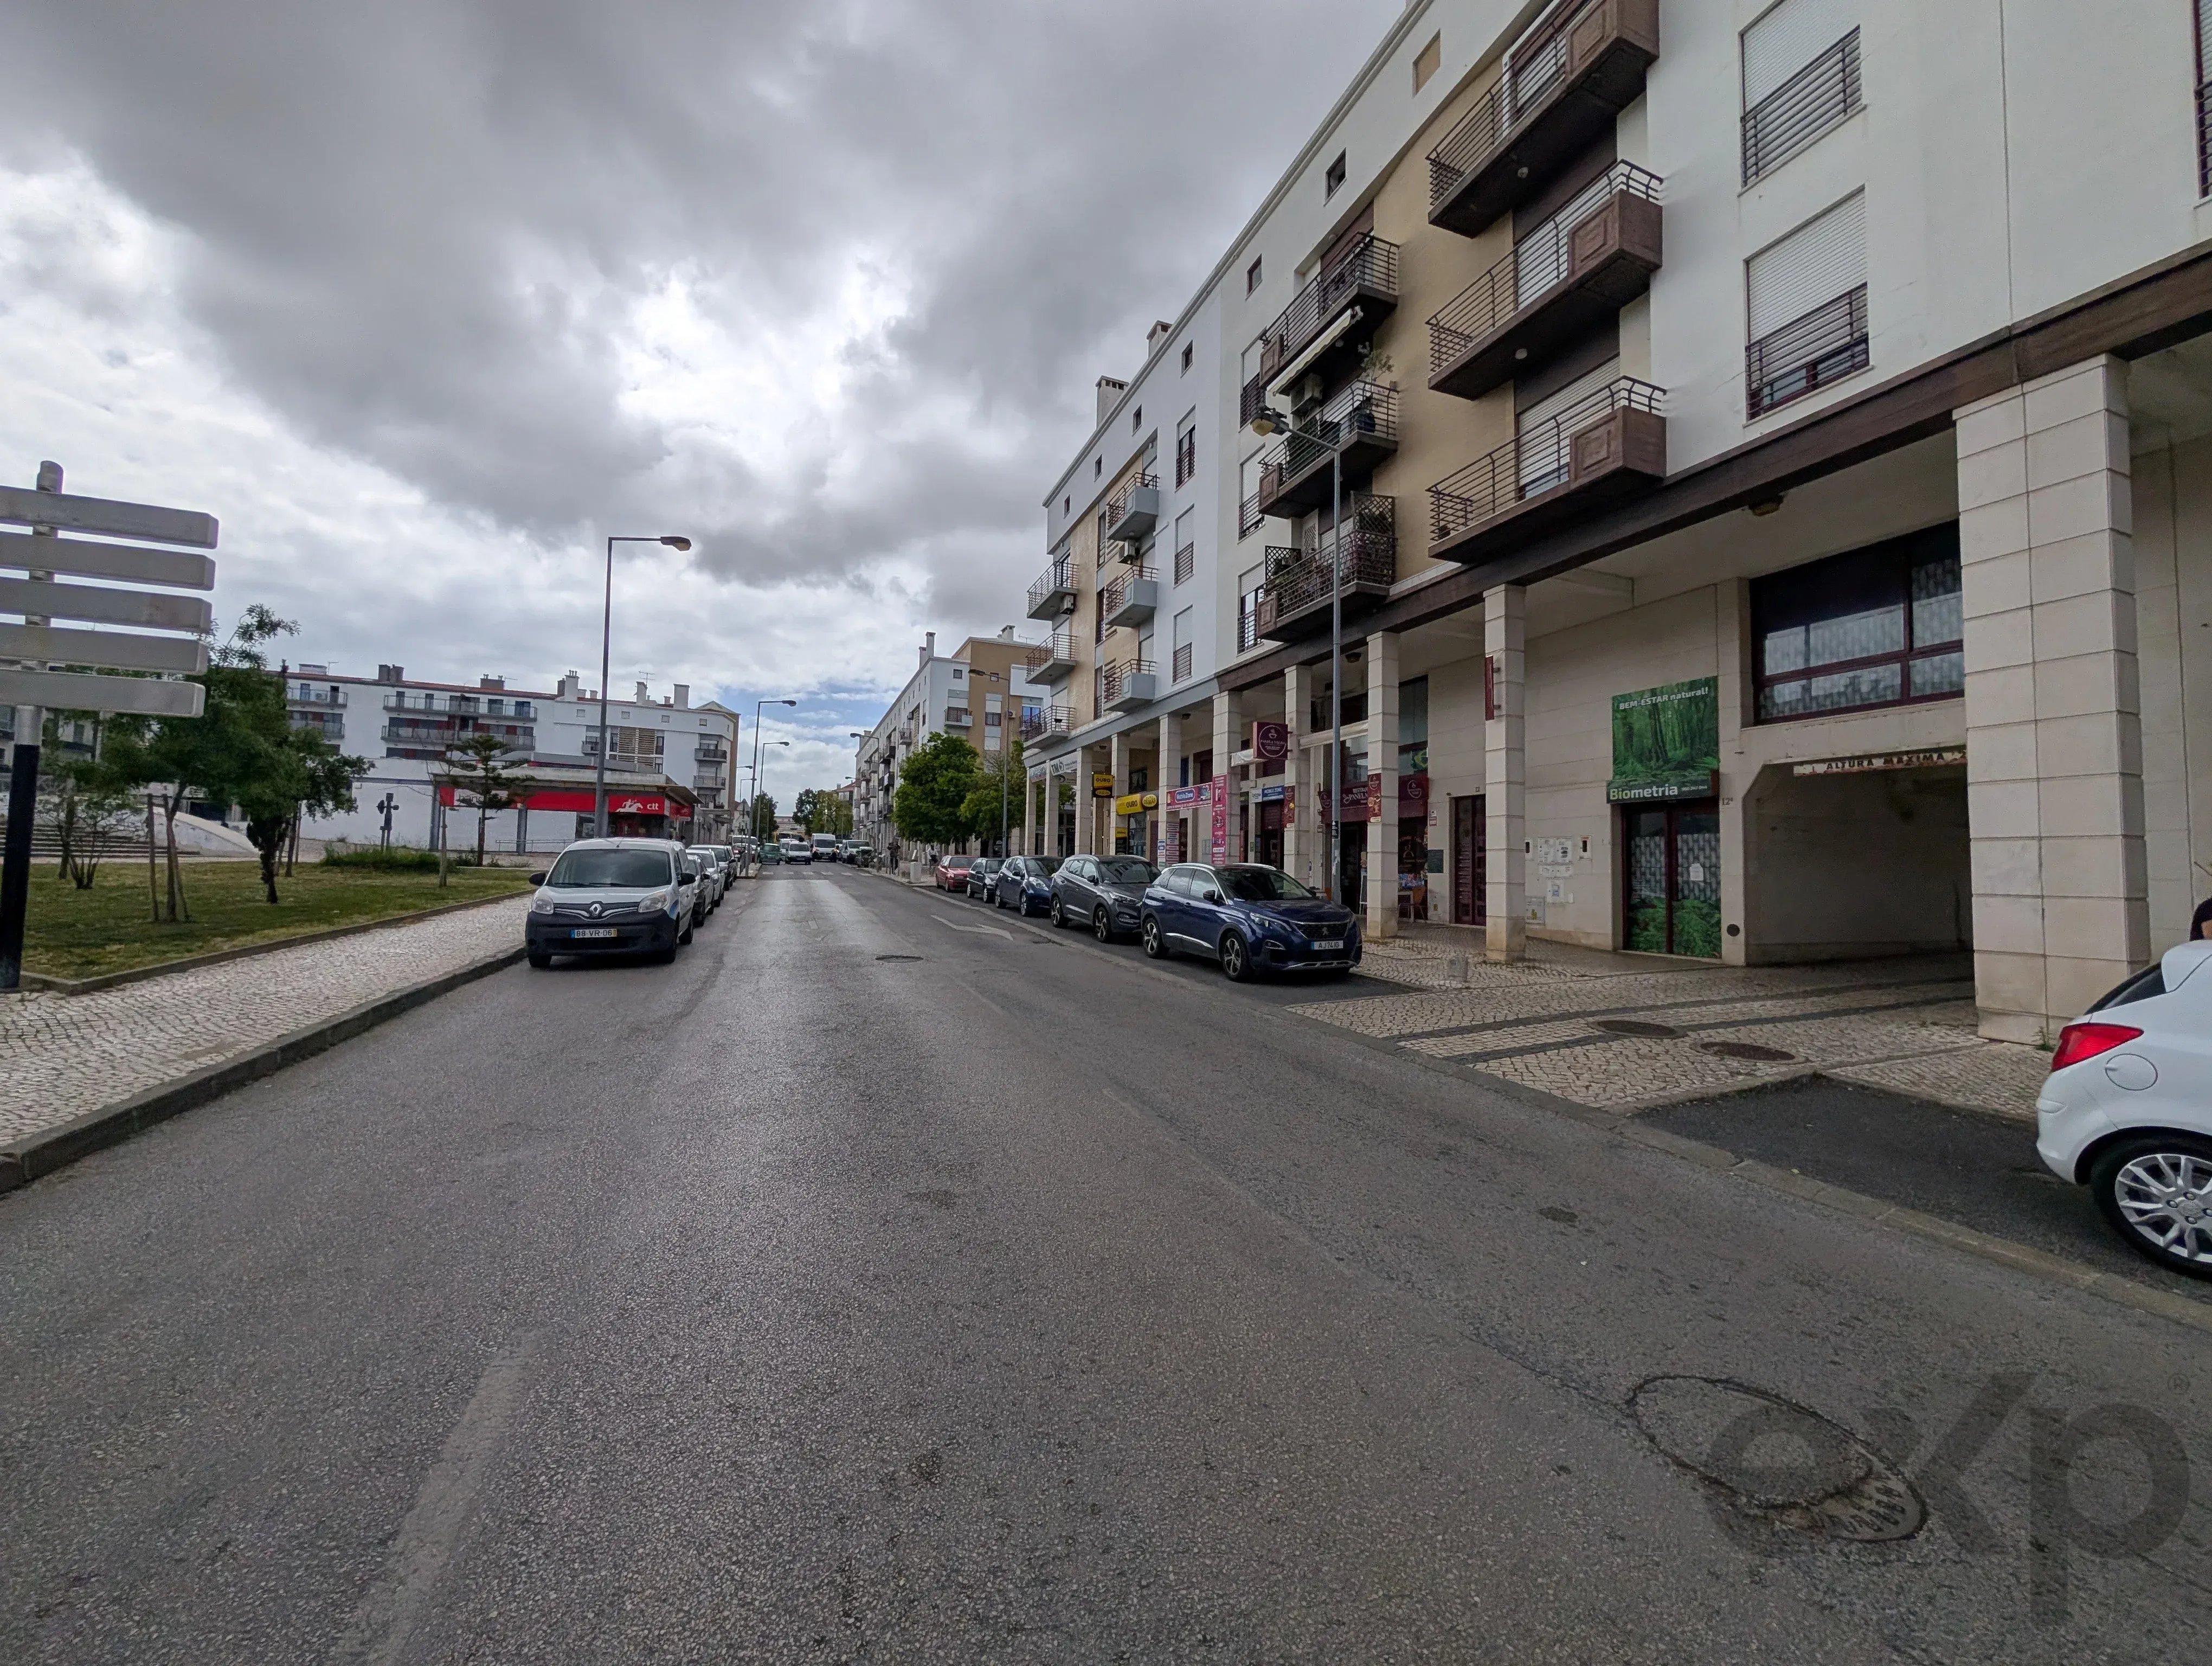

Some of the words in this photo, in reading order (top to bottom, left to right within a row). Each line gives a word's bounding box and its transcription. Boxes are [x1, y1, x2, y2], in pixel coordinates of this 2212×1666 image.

[1619, 694, 1668, 710] BEM-ESTAR
[1670, 687, 1708, 700] natural!
[1826, 759, 1875, 770] ALTURA
[1610, 784, 1678, 800] Biometria
[1126, 800, 1138, 808] OURO
